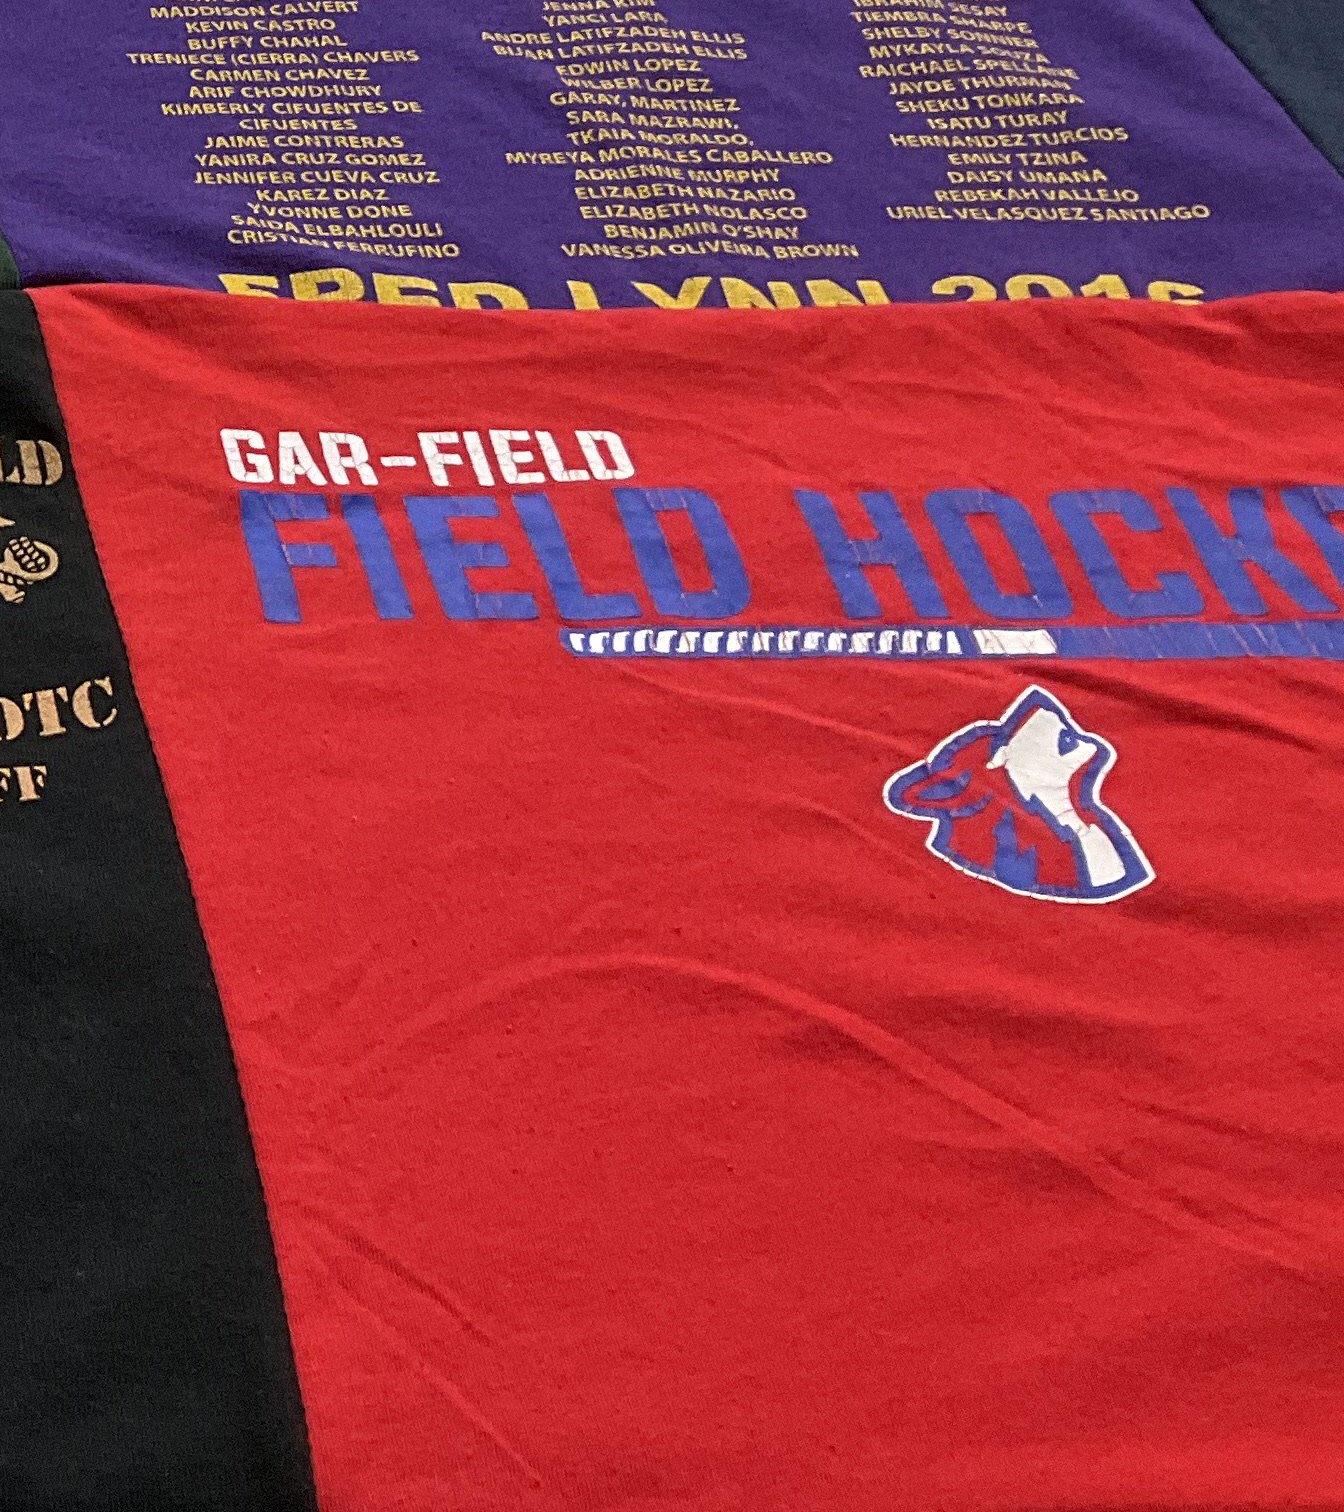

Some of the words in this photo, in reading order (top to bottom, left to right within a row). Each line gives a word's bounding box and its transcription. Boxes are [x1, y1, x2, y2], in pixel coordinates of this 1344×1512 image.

[185, 20, 249, 33] KEVIN
[253, 18, 336, 31] CASTRO
[126, 53, 226, 64] TRENIECE
[231, 53, 319, 66] (CIERRA)
[323, 50, 420, 62] CHAVERS
[555, 59, 630, 77] EDWIN
[634, 59, 702, 74] LOPEZ
[889, 78, 956, 95] JAYDE
[959, 76, 1072, 91] THURMAN
[161, 103, 265, 115] KIMBERLY
[272, 102, 388, 114] CIFUENTES
[392, 100, 423, 113] DE
[895, 97, 970, 114] SHEKU
[972, 92, 1086, 110] TONKARA
[889, 133, 1028, 148] HERNANDEZ
[1029, 127, 1129, 146] TURCIOS
[505, 152, 595, 165] MYREYA
[599, 146, 702, 164] MORALES
[705, 149, 834, 165] CABALLERO
[947, 152, 1012, 166] EMILY
[1015, 150, 1088, 167] TZINA
[574, 164, 685, 182] ADRIENNE
[688, 168, 780, 183] MURPHY
[256, 189, 330, 202] KAREZ
[333, 189, 389, 201] DIAZ
[934, 188, 1040, 203] REBEKAH
[1040, 188, 1139, 204] VALLEJO
[886, 206, 952, 221] URIEL
[953, 208, 1089, 222] VELASQUEZ
[1090, 204, 1211, 222] SANTIAGO
[219, 429, 637, 486] GAR-FIELD
[238, 488, 754, 624] FIELD
